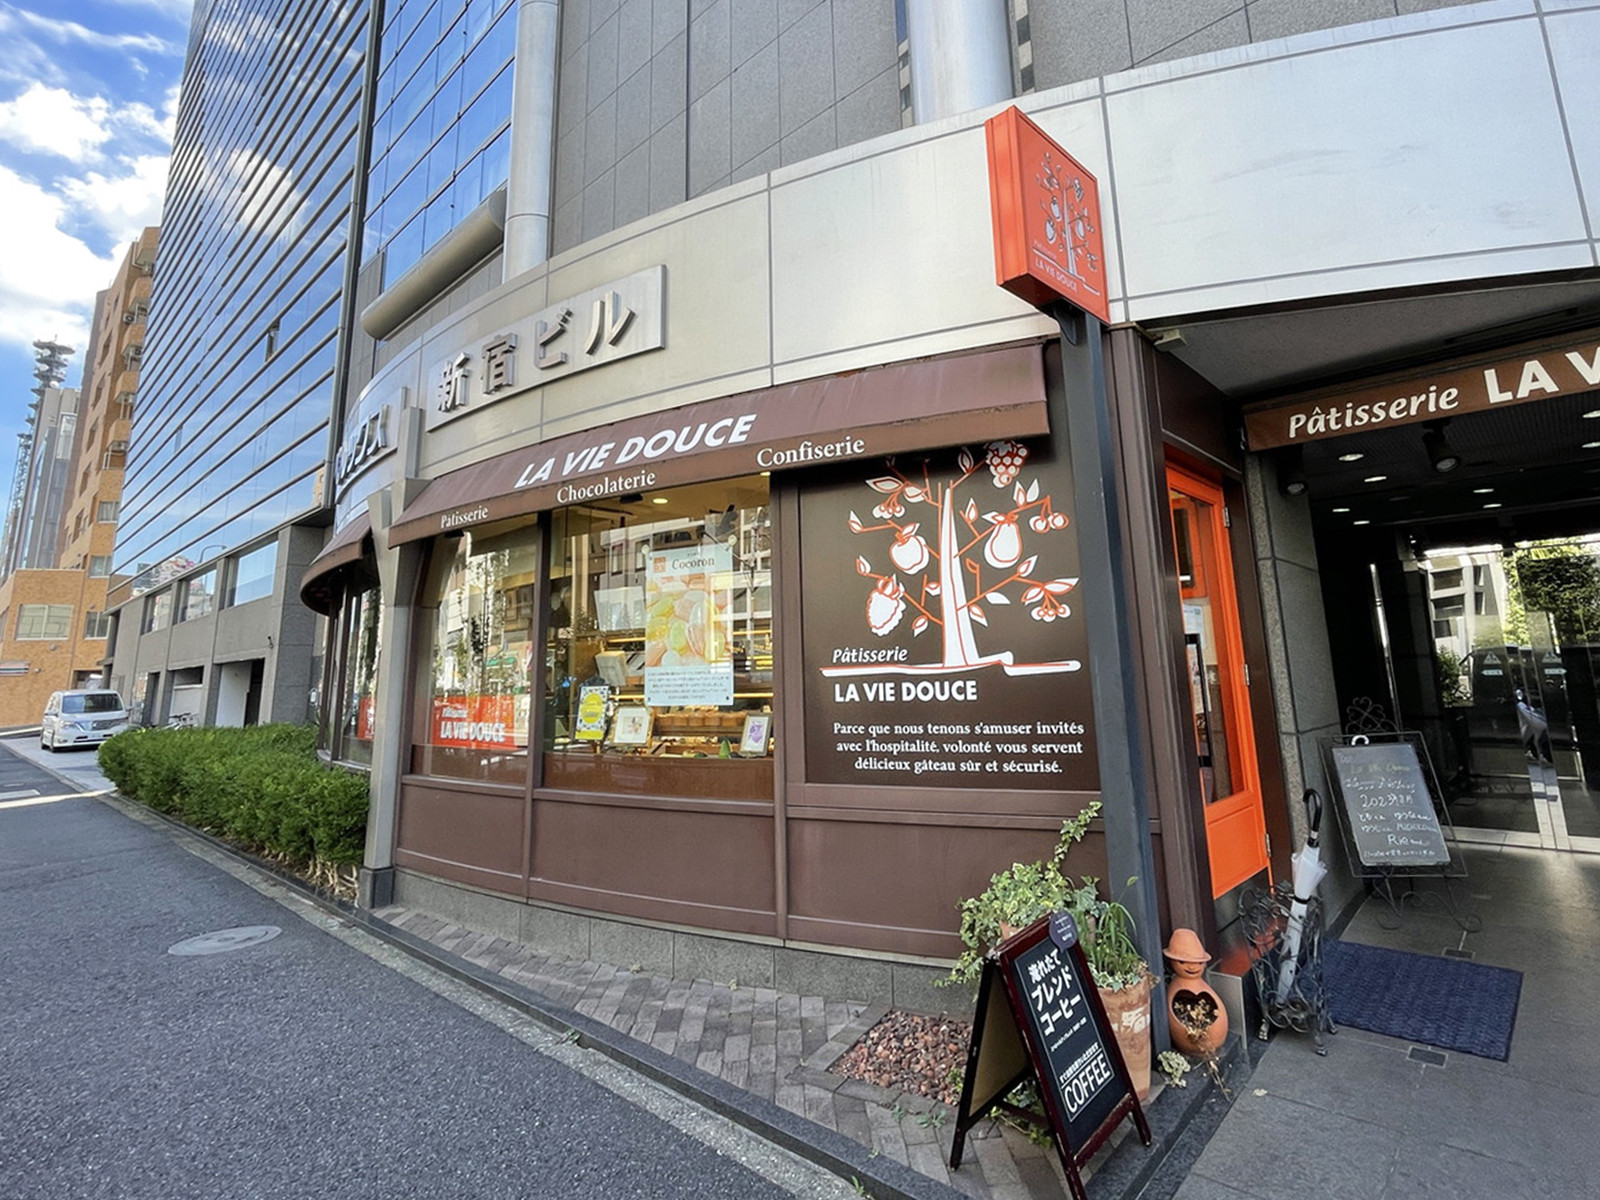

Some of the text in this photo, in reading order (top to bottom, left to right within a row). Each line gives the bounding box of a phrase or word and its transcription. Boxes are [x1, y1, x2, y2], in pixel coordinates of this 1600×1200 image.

[438, 290, 636, 412] 新宿ビル
[1288, 385, 1459, 438] Pâtisserie
[1484, 360, 1559, 403] LA
[514, 413, 757, 488] LA VIE DOUCE
[756, 436, 865, 467] Confiserie
[557, 470, 656, 504] Chocolaterie
[672, 558, 715, 570] Cocoron
[832, 646, 908, 663] Pâtisserie
[834, 680, 977, 702] LA VIE DOUCE
[440, 721, 453, 739] LA
[469, 721, 506, 742] DOUCE
[833, 721, 1085, 737] Parce que nous tenons s'amuser invités
[836, 742, 862, 752] avec
[942, 740, 992, 753] volonté
[995, 743, 1028, 753] vous
[1031, 741, 1083, 753] servent
[854, 757, 1063, 774] délicieux gâteau sûr et sécurisé.
[1031, 965, 1073, 1012] ブレンド
[1040, 994, 1081, 1037] コーヒー
[1064, 1053, 1111, 1113] COFFEE
